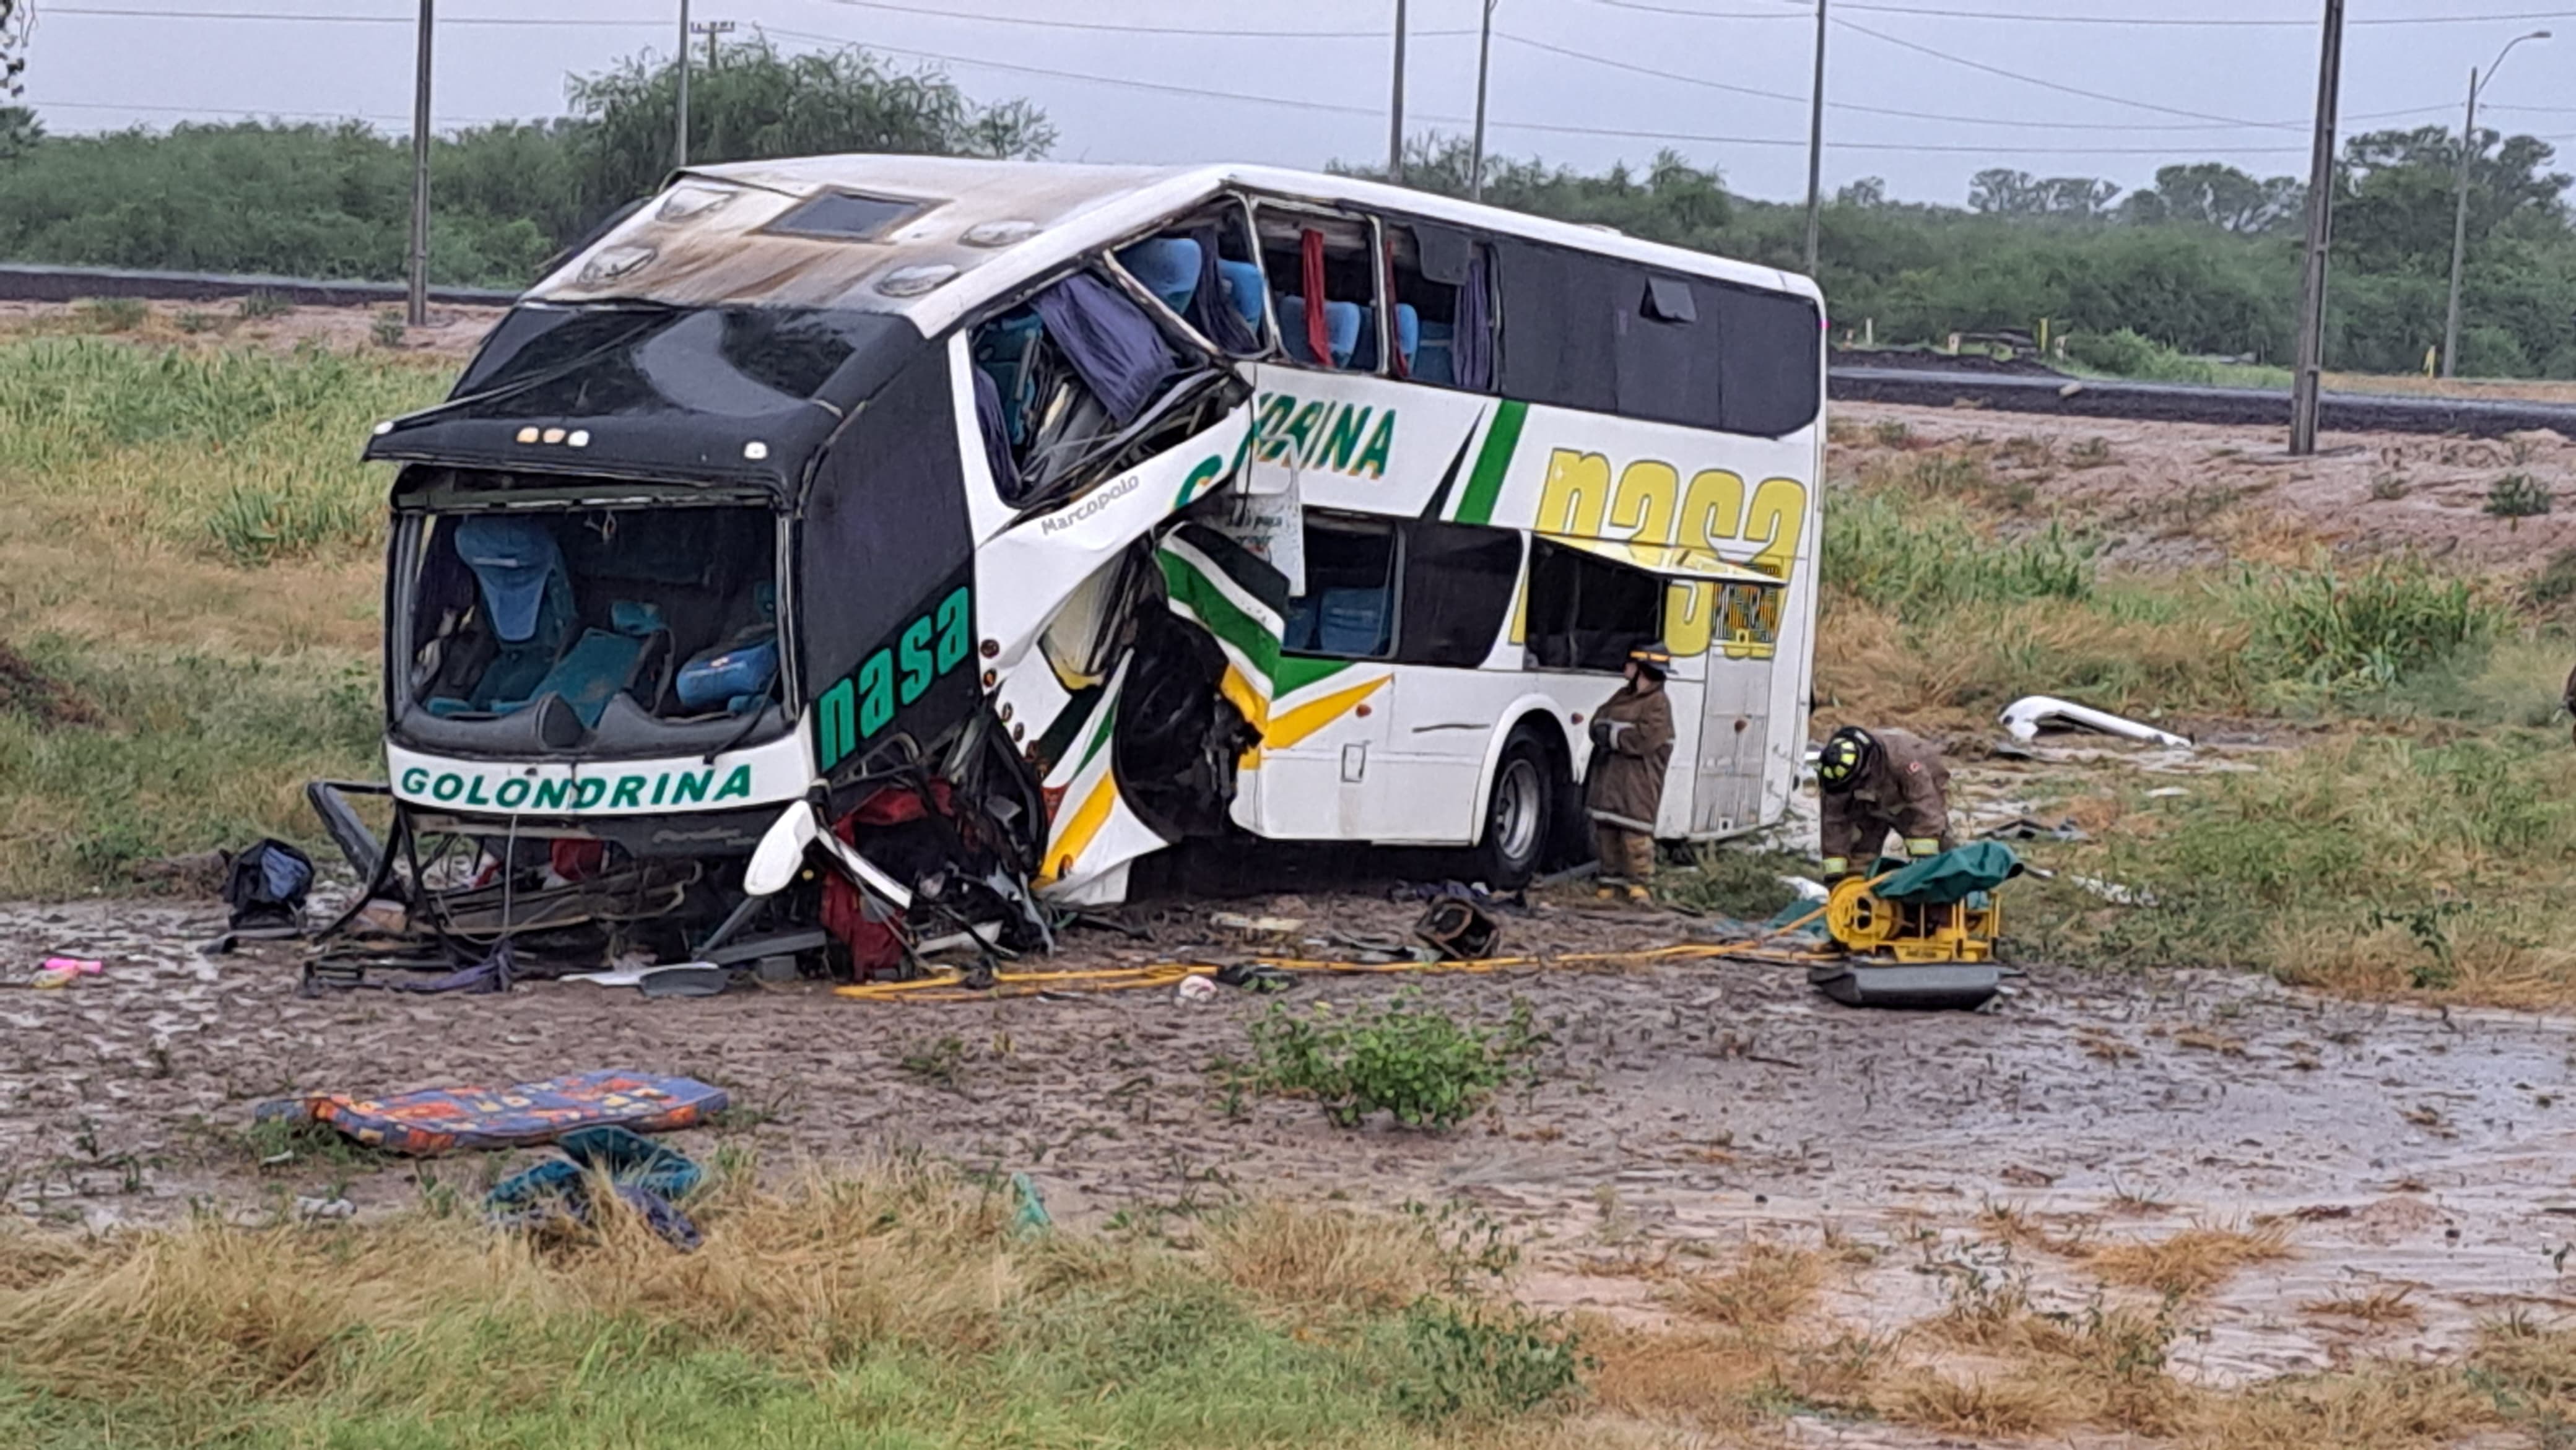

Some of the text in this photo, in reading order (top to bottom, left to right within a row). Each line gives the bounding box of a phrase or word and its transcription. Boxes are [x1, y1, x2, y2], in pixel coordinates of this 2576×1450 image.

[1041, 475, 1140, 536] Marcopolo
[819, 586, 968, 772] nasa
[401, 763, 751, 810] GOLONDRINA
